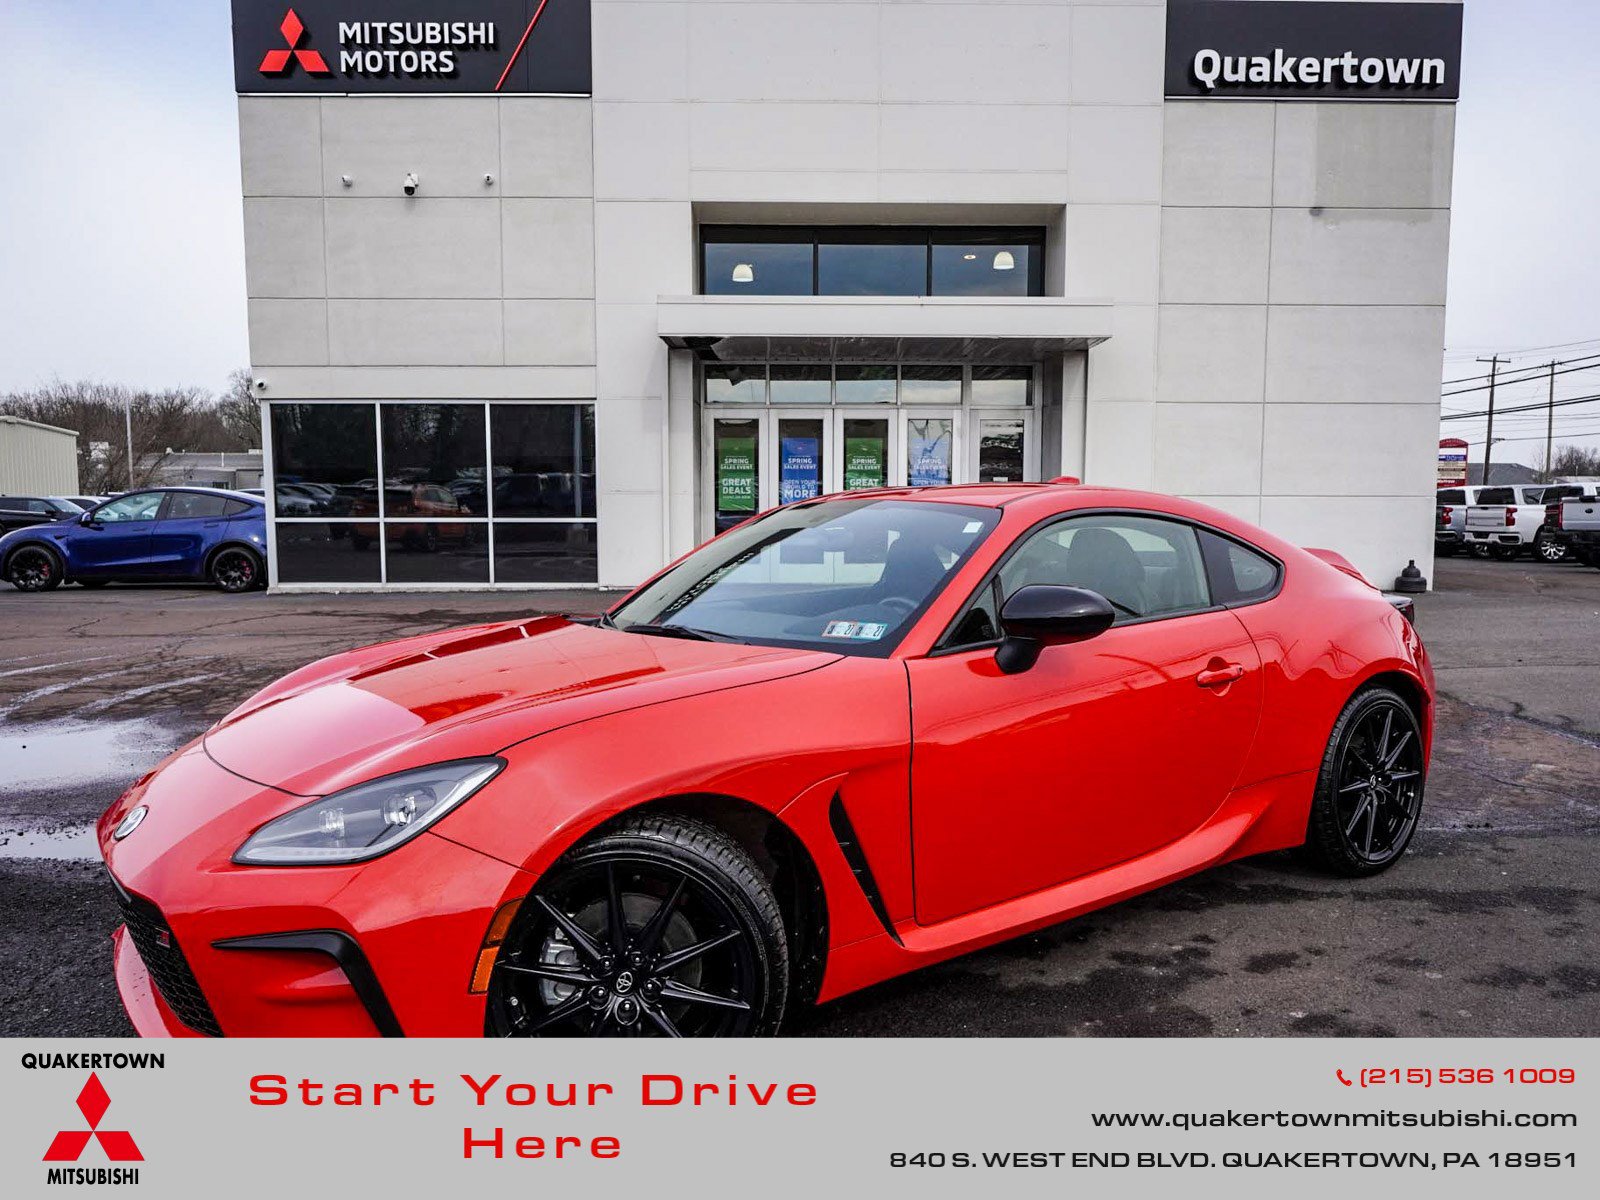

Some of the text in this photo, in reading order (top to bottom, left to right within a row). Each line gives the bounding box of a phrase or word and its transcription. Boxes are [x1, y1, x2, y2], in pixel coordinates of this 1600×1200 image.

[338, 21, 494, 45] MITSUBISHI
[340, 51, 455, 73] MOTORS
[1194, 48, 1445, 89] Quakertown
[722, 478, 752, 486] GREAT
[849, 478, 879, 486] GREAT
[722, 486, 752, 495] DEALS
[784, 490, 816, 498] MORE
